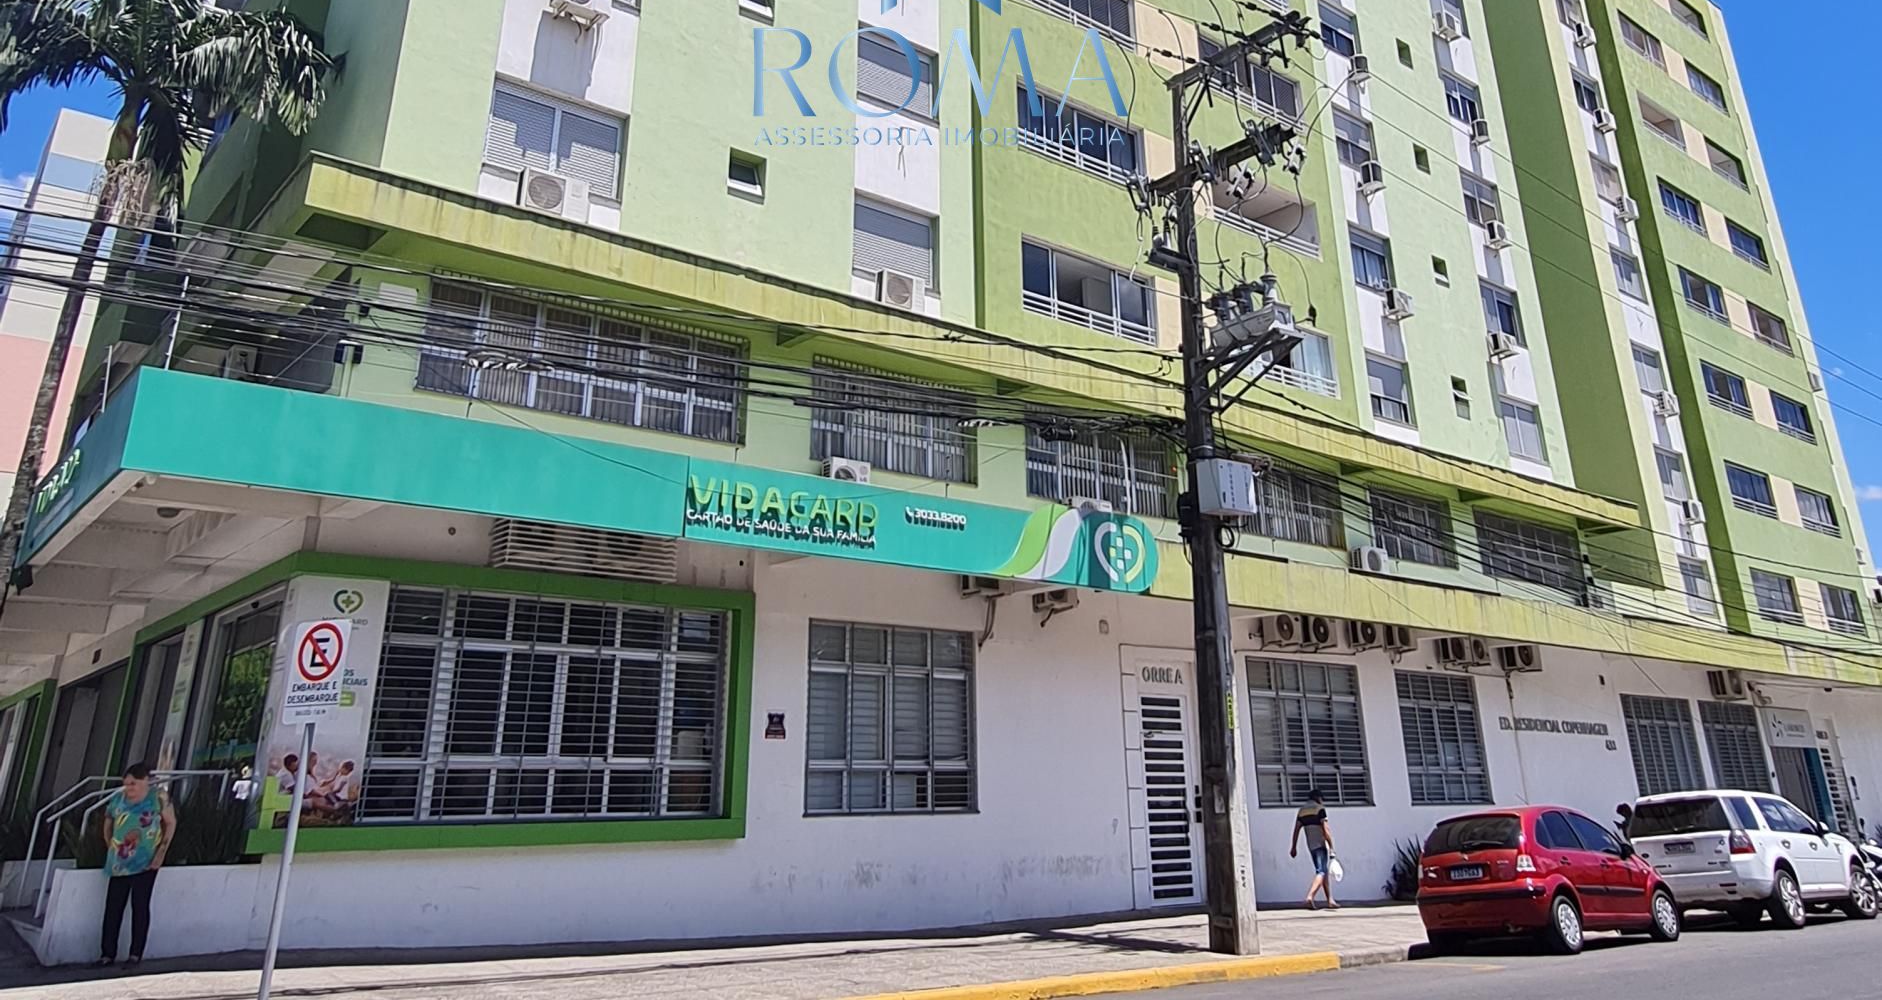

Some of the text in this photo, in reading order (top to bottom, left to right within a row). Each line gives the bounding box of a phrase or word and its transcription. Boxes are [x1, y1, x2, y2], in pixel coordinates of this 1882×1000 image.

[691, 474, 879, 527] VIDACARD
[686, 508, 733, 525] CARTÃO
[736, 517, 751, 528] DE
[755, 517, 792, 533] SAÚDE
[795, 525, 810, 536] DA
[813, 526, 834, 538] SUA
[292, 680, 338, 692] EMBARQUE E
[287, 692, 339, 704] DESEMBARQUE
